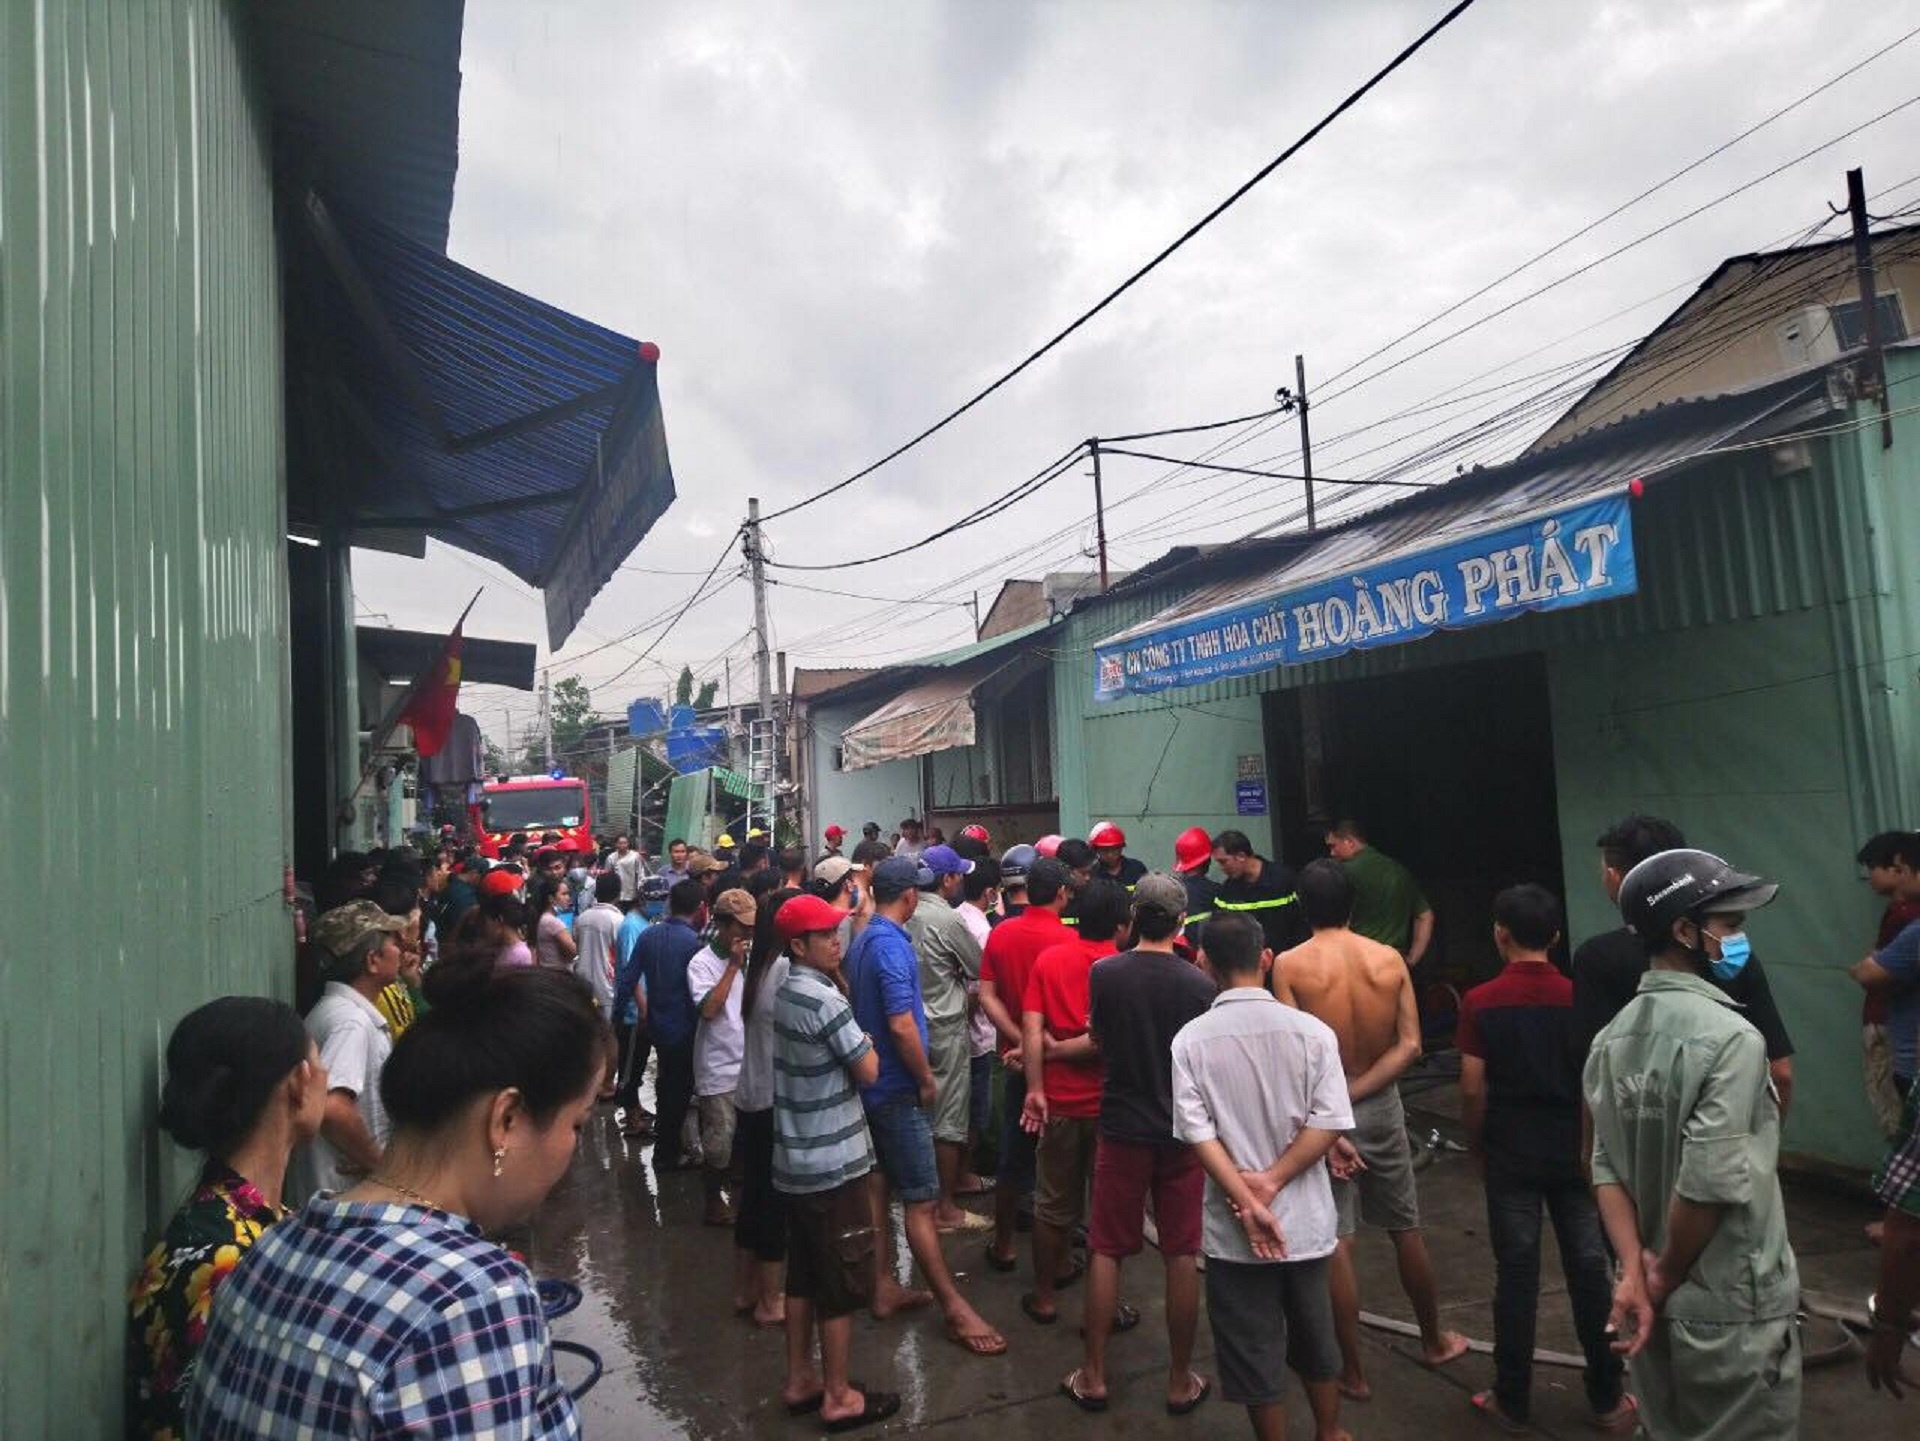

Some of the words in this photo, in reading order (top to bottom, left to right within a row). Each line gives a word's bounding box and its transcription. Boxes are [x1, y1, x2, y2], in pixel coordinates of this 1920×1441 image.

[1294, 570, 1449, 652] HOÀNG
[1458, 519, 1617, 614] PHÁT
[1142, 640, 1170, 671] CÔNG
[1172, 641, 1186, 664] TY
[1188, 629, 1221, 661] TNHH
[1223, 617, 1250, 652] HÓA
[1253, 602, 1287, 644] CHẤT
